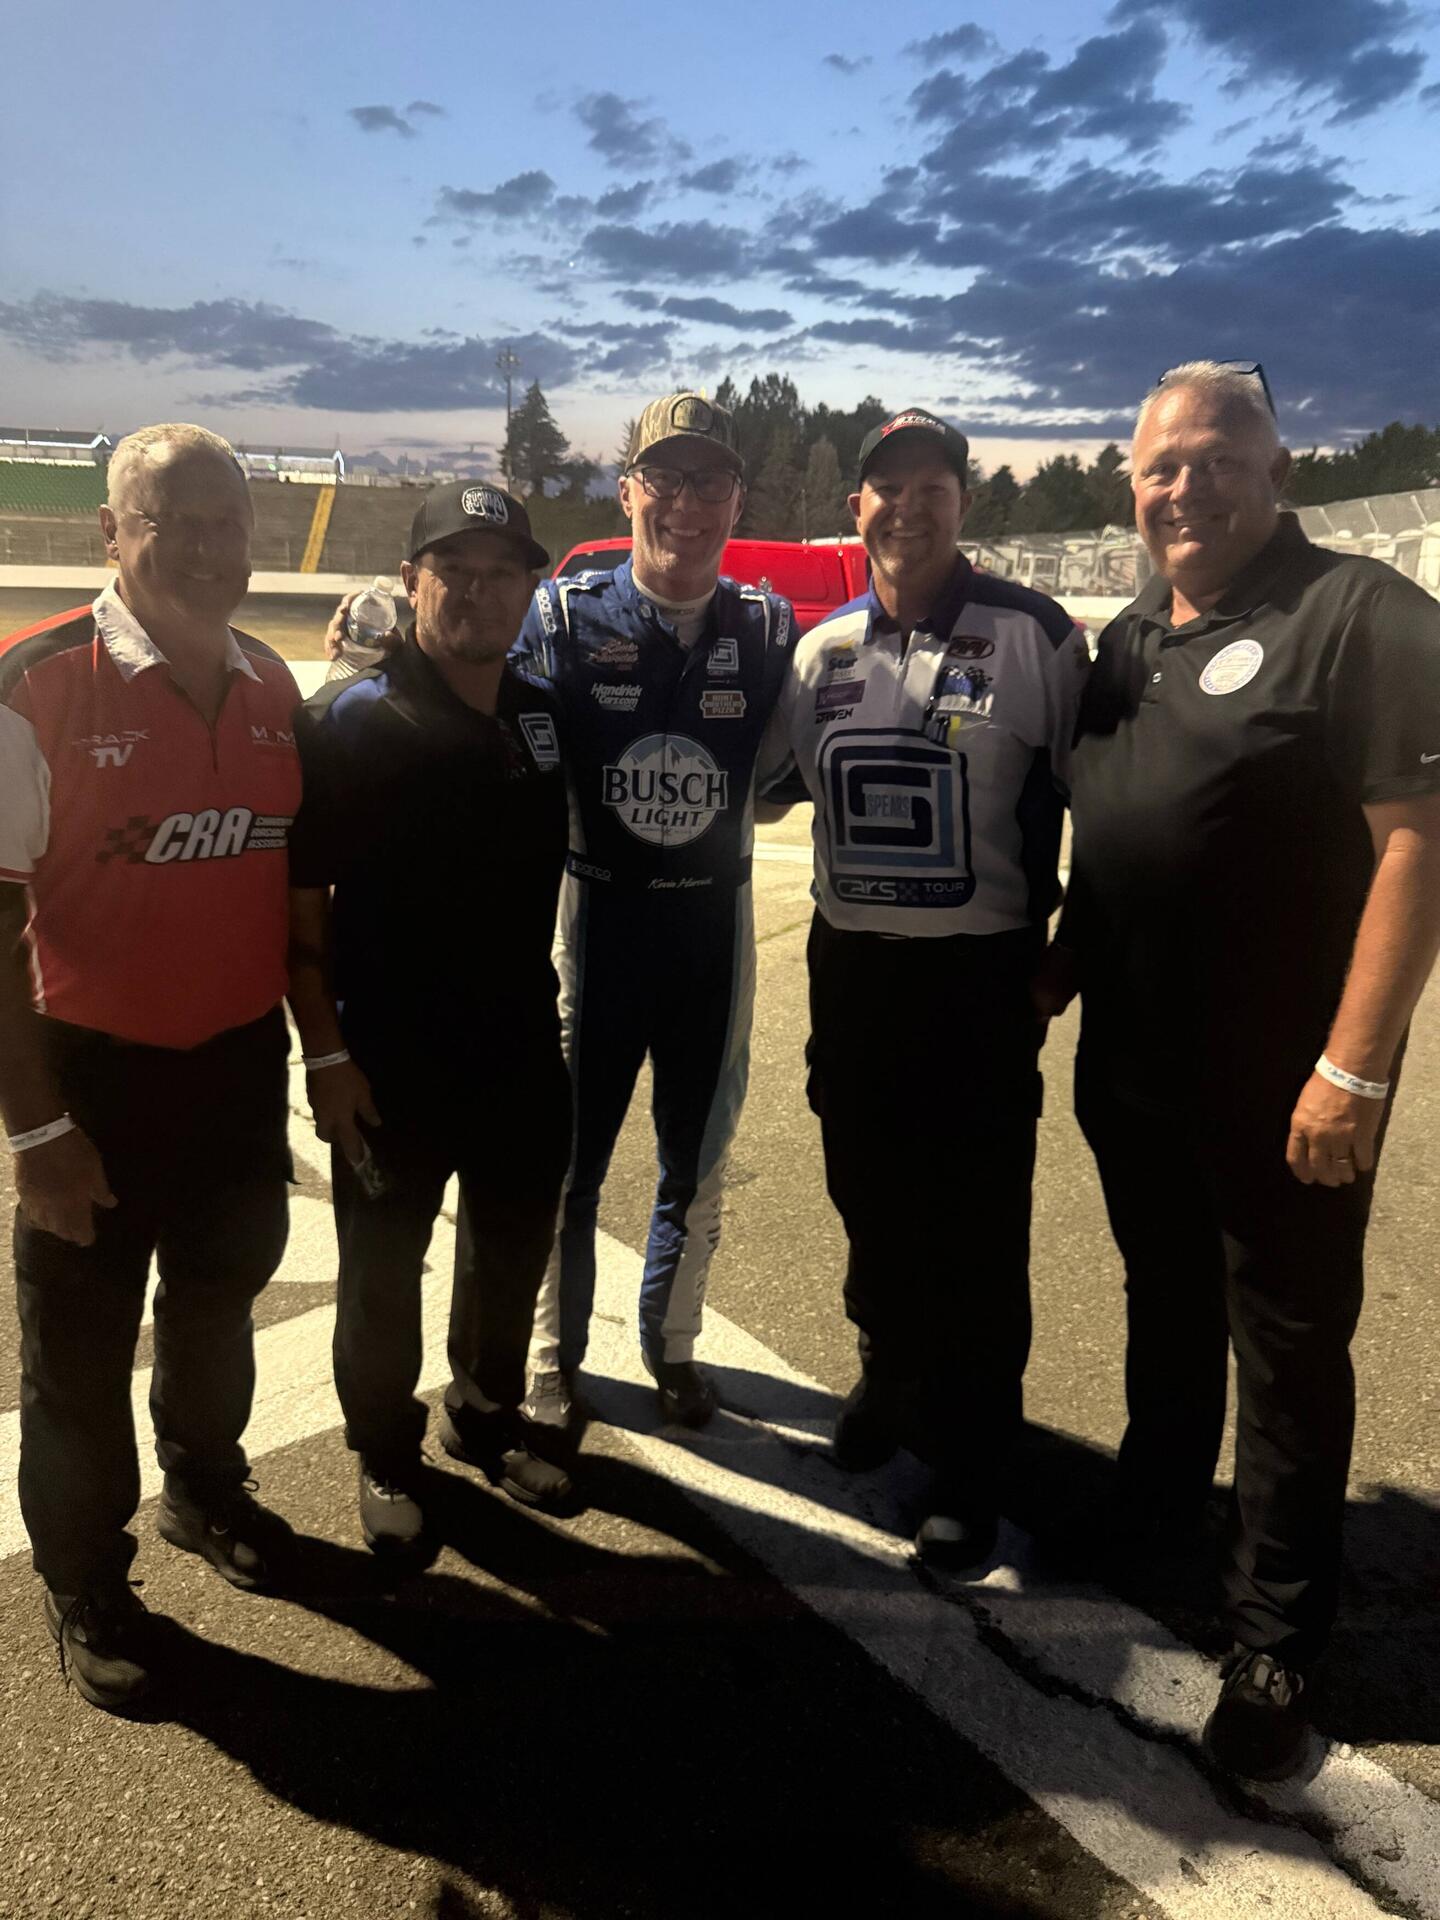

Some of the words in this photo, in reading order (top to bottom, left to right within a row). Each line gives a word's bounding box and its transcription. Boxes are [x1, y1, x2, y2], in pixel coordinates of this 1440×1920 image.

[591, 682, 643, 699] Hendrick
[90, 744, 134, 768] TV
[603, 766, 728, 810] BUSCH
[631, 808, 703, 827] LIGHT
[866, 793, 911, 818] SPEARS
[145, 807, 252, 863] CRA
[923, 882, 965, 893] TOUR
